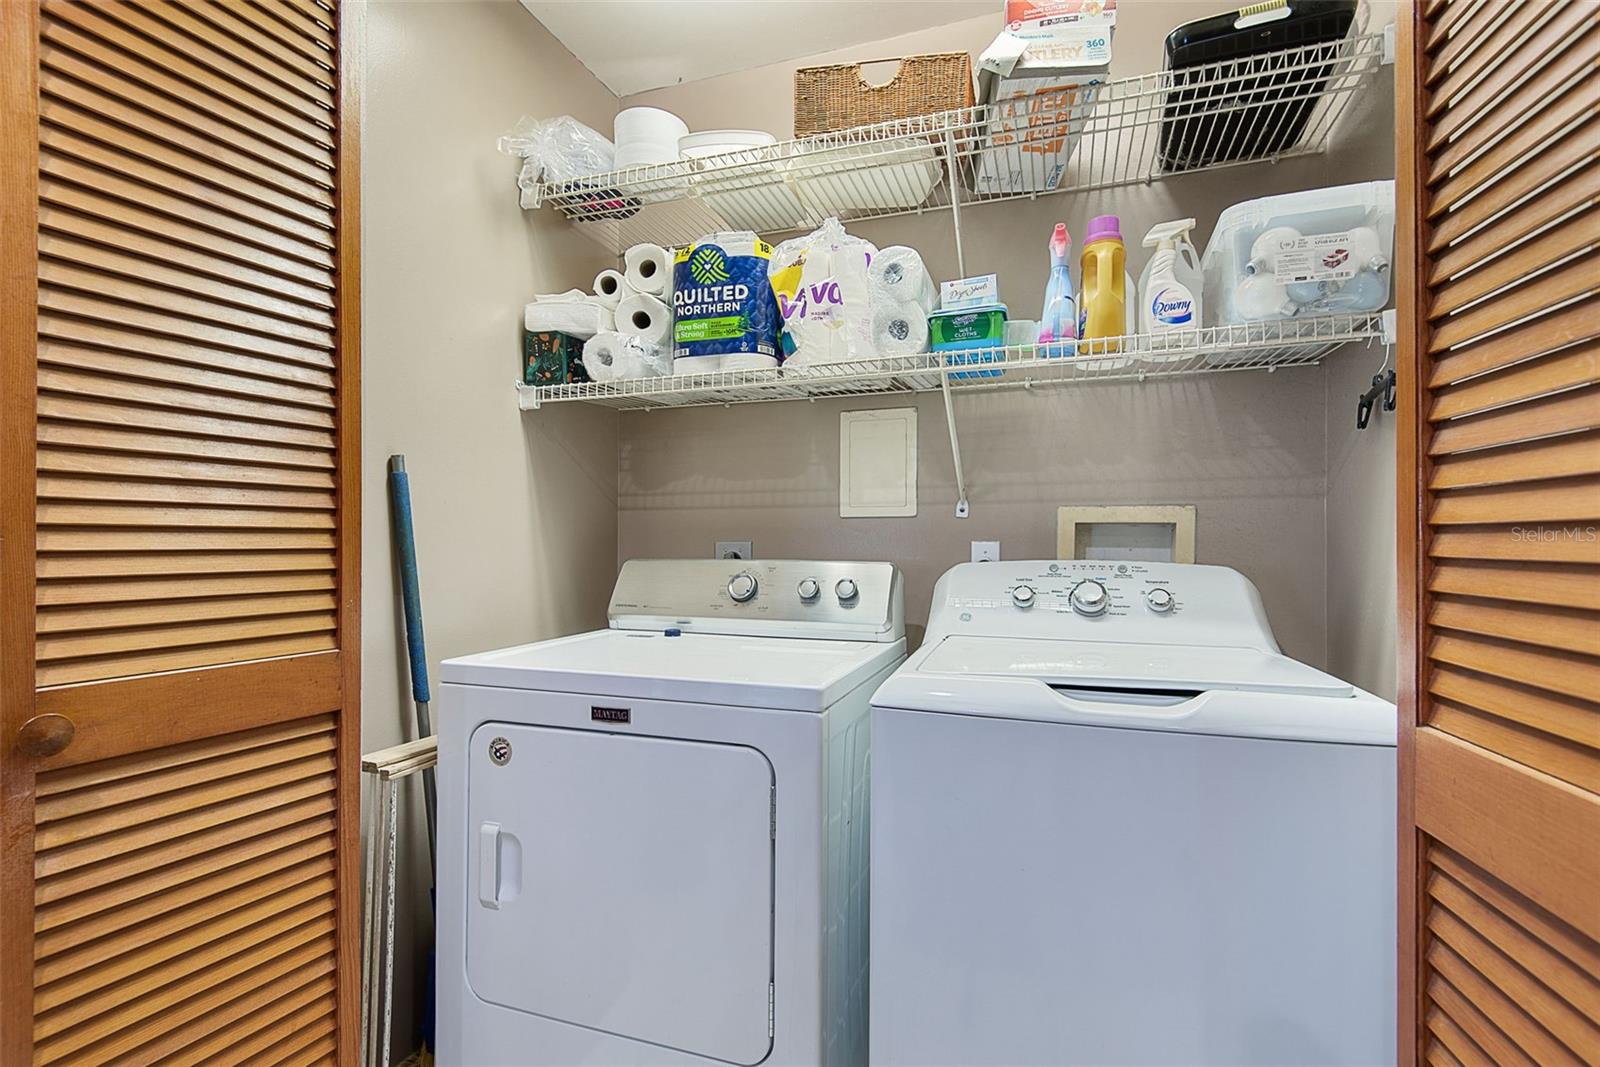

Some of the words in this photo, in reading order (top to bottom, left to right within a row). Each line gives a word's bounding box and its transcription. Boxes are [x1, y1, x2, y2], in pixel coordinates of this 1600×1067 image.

[1086, 38, 1105, 48] 360
[673, 284, 749, 306] QUILTED
[677, 301, 741, 317] NORTHERN
[1157, 300, 1192, 315] Downy
[592, 709, 628, 720] MAYTAG
